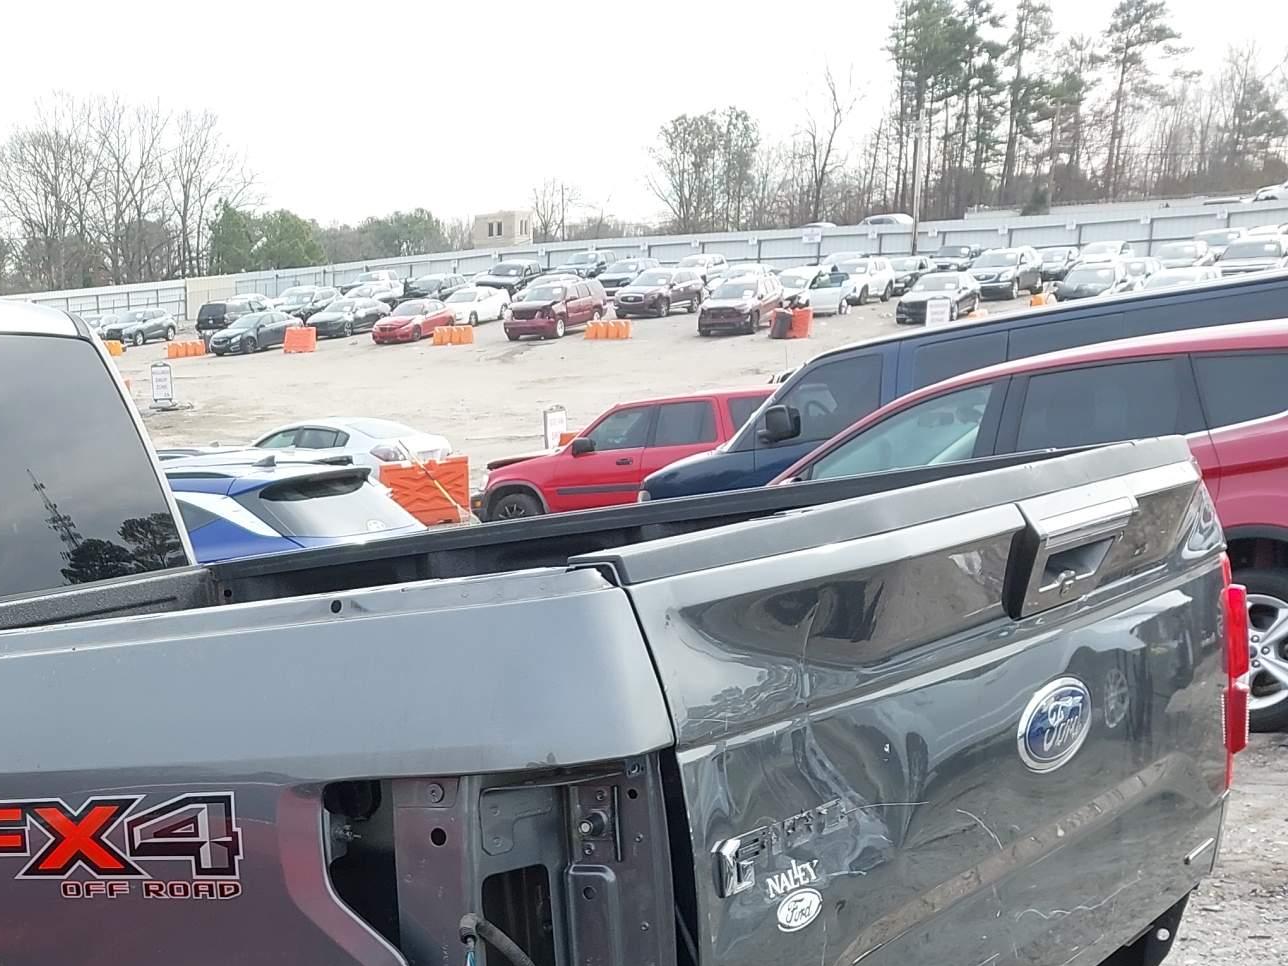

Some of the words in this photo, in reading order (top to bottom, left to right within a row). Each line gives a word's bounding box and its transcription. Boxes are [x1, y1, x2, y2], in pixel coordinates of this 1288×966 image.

[1043, 695, 1083, 752] Ford
[60, 880, 132, 899] OFF
[143, 880, 241, 900] ROAD
[765, 859, 819, 898] NALLEY
[784, 898, 814, 924] Ford
